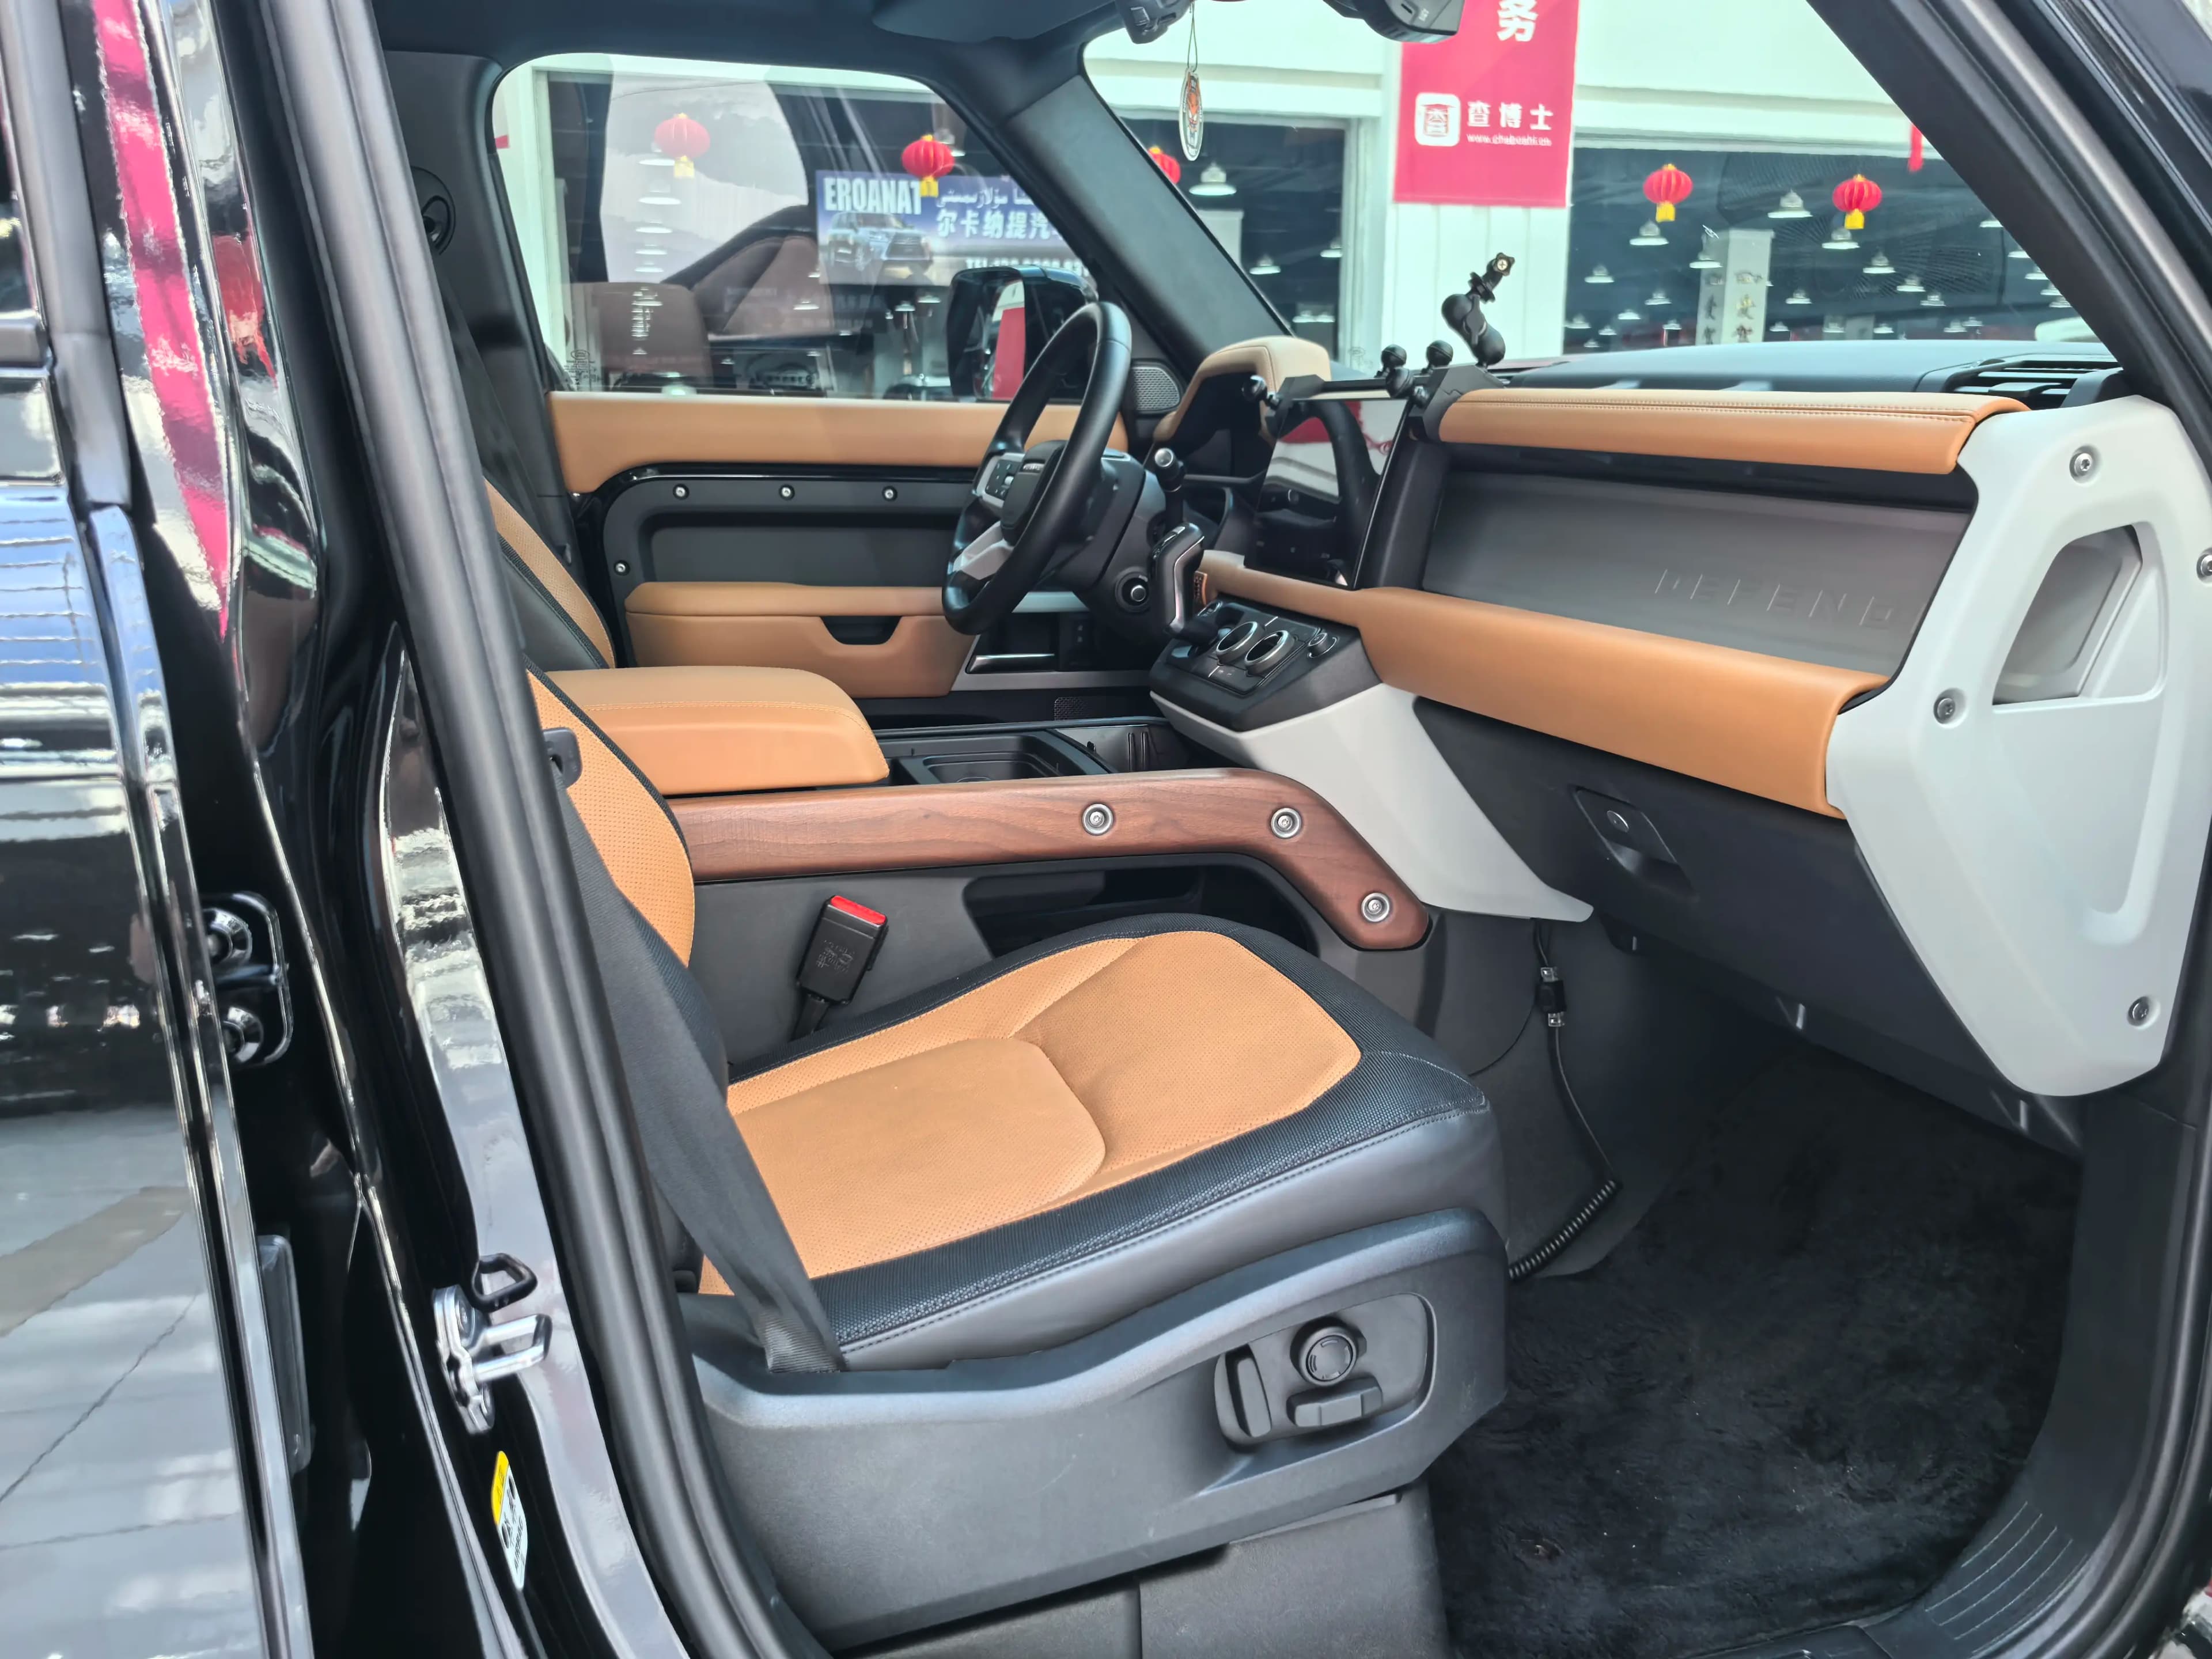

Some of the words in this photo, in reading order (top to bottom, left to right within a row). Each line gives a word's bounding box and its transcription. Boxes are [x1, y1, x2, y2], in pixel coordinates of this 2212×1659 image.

[1467, 100, 1553, 130] 查博士
[937, 208, 1062, 240] 尔卡纳提汽
